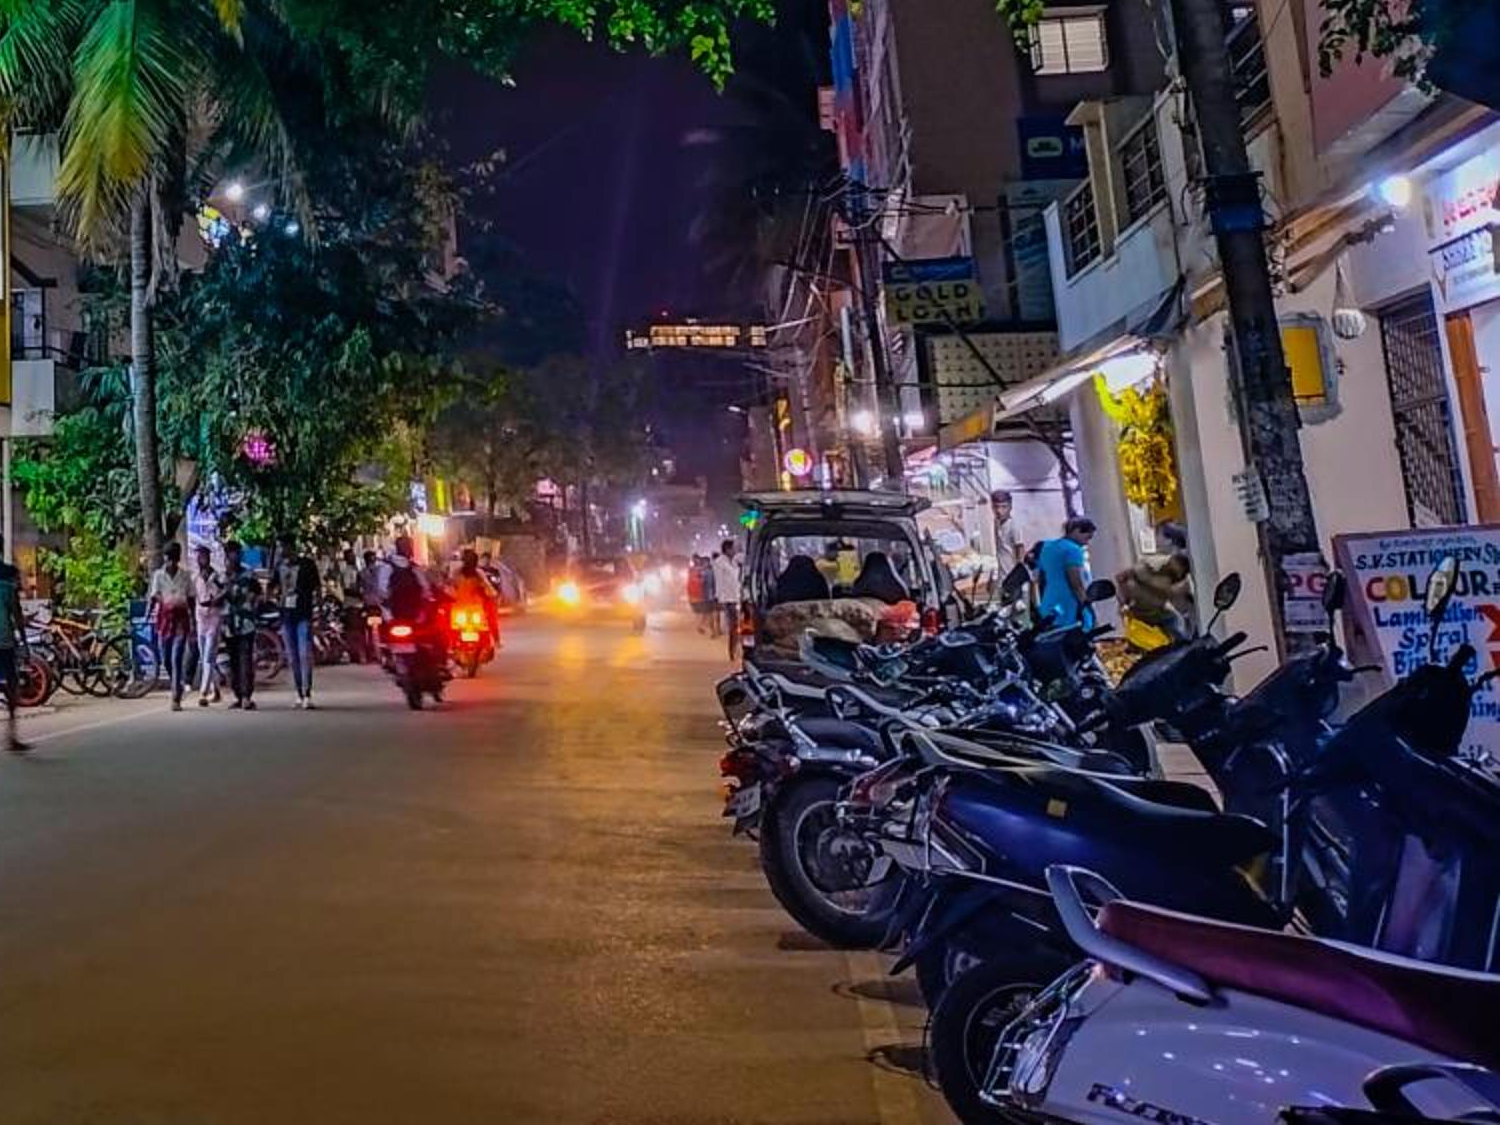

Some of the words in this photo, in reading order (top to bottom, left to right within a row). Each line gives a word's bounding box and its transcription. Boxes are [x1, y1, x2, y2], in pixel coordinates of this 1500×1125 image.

[896, 283, 968, 301] GOLD
[1366, 570, 1492, 601] COLUR
[1399, 623, 1470, 653] Spral
